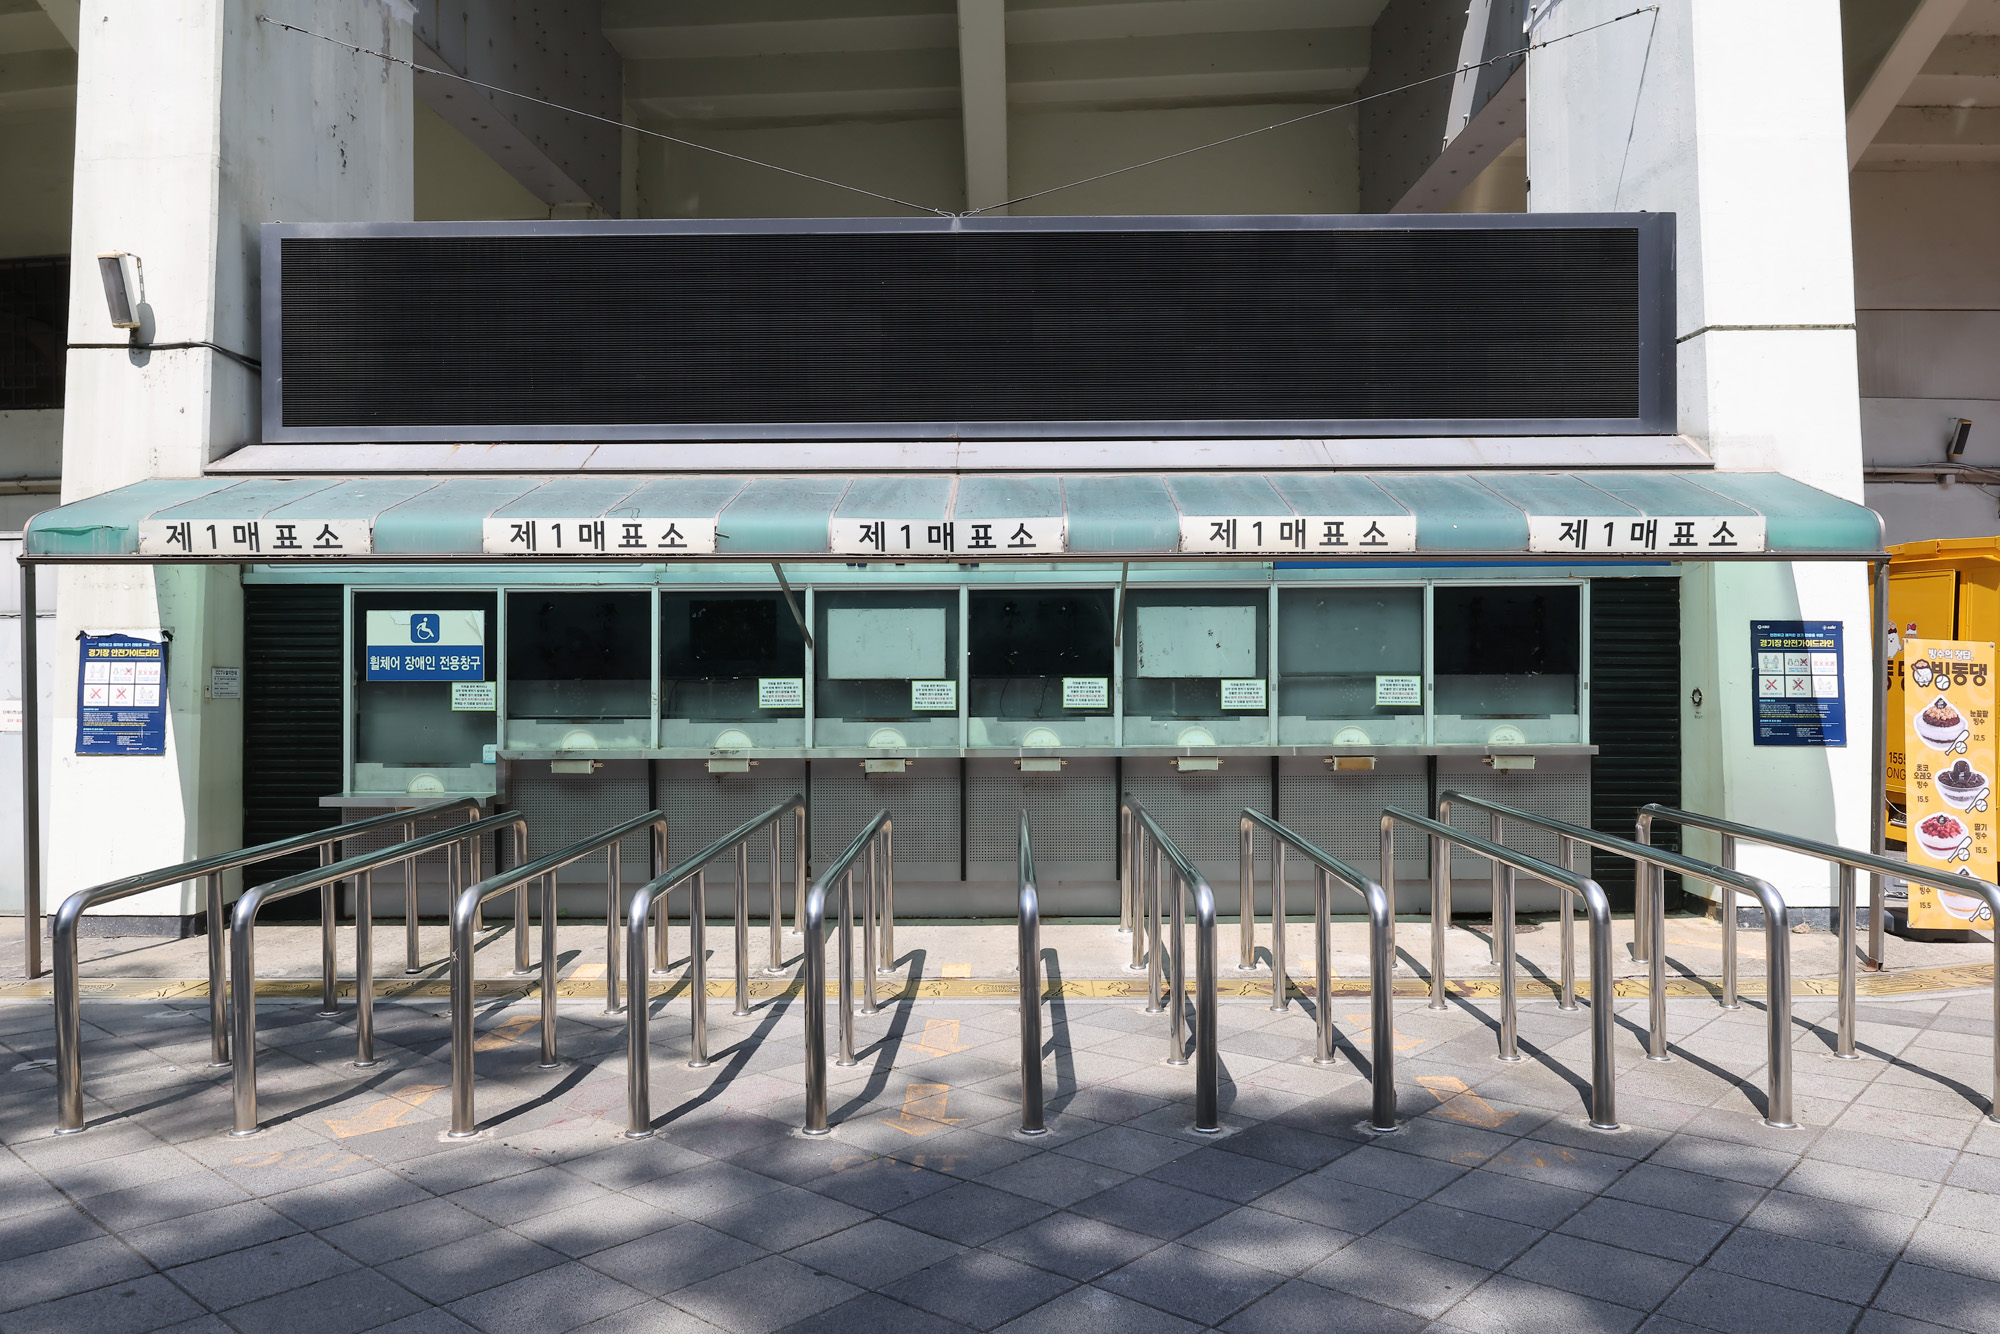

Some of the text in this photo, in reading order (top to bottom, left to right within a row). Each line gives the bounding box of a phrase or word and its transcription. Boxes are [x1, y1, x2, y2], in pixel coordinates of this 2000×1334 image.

[1760, 639, 1834, 648] 경기장 안전가이드라인
[88, 648, 159, 657] 경기장 안전가이드라인
[1928, 648, 1974, 661] 빙수의 정답,
[369, 656, 481, 671] 휠체어 장애인 전용창구
[1973, 718, 1985, 726] 빙수
[1913, 772, 1932, 780] 오레오
[1917, 795, 1929, 803] 15.5
[1974, 823, 1988, 831] 딸기
[1975, 832, 1987, 840] 빙수
